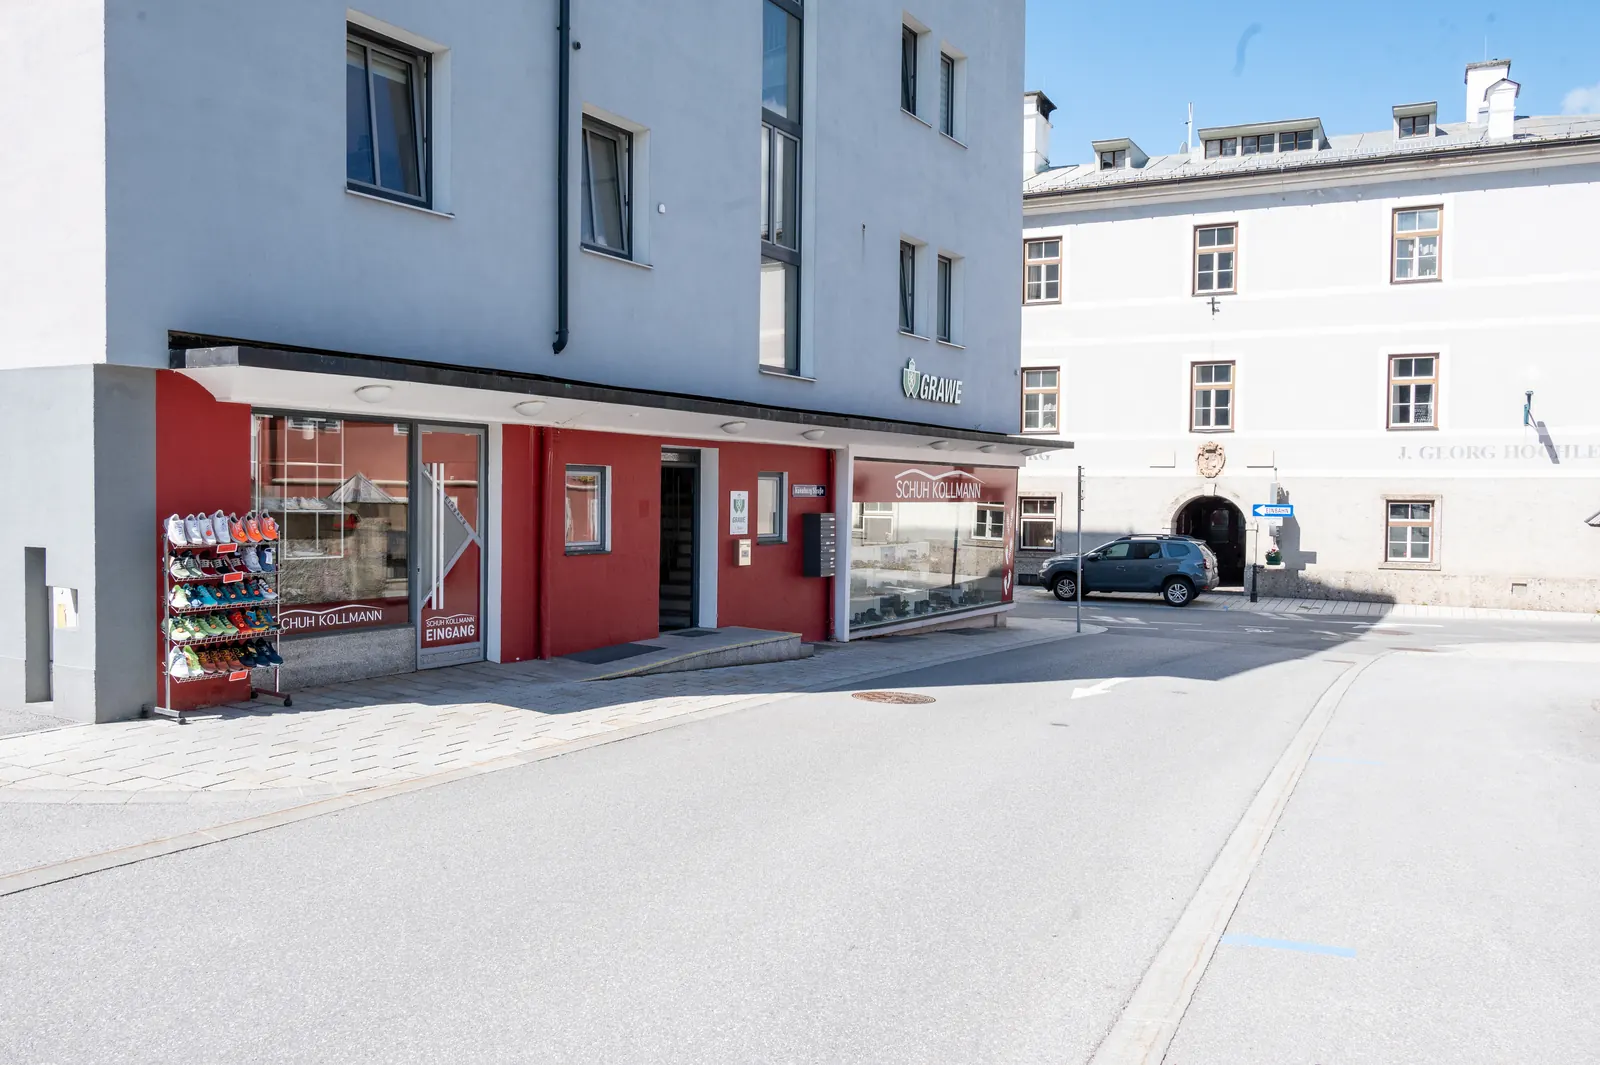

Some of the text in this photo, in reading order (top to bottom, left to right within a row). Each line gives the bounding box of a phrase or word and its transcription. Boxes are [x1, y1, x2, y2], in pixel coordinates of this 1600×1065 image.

[920, 374, 963, 405] GRAWE
[1419, 445, 1496, 460] GEORG
[895, 480, 981, 499] SCHUH KOLLMANN
[318, 609, 383, 626] KOLLMANN
[426, 616, 475, 628] SCHUH KOLLMANN
[426, 624, 475, 642] EINGANG
